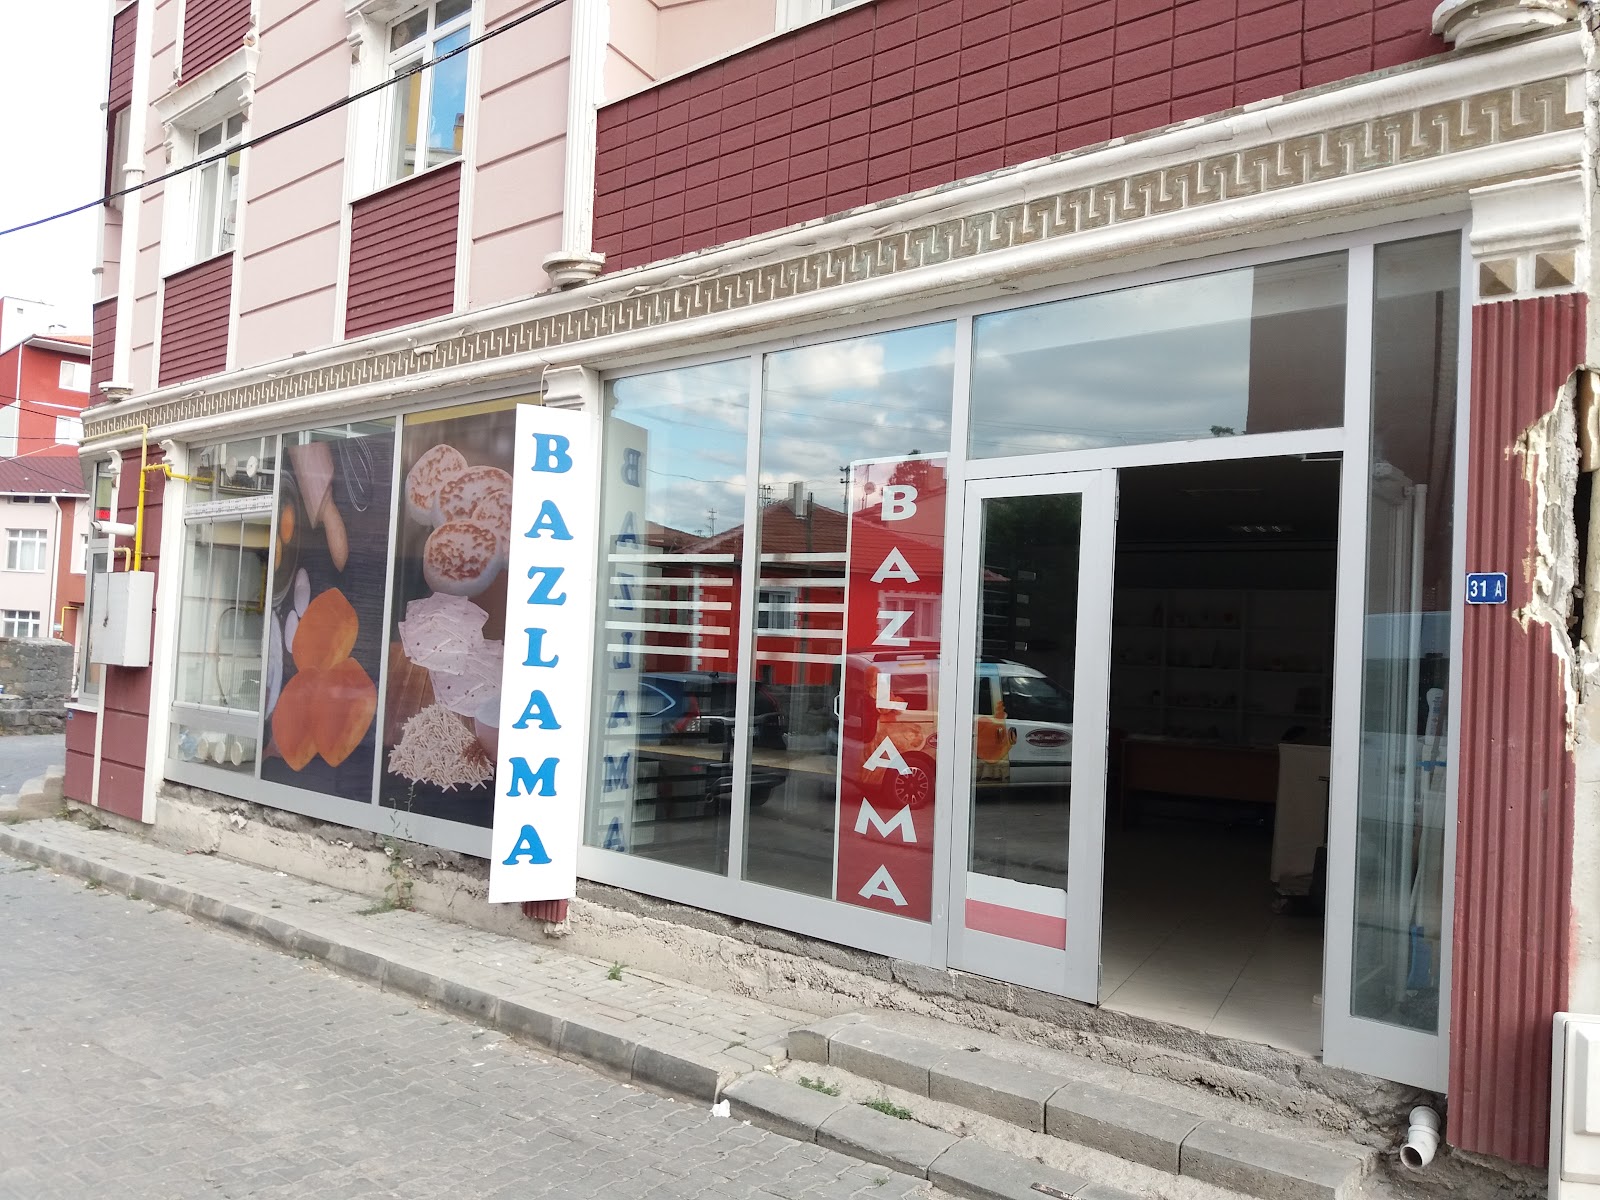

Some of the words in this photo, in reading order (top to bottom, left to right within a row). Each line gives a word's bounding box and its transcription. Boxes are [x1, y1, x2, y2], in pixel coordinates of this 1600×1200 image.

[502, 433, 574, 867] BAZLAMA
[853, 484, 921, 907] BAZLAMA
[1470, 580, 1487, 597] 31
[1495, 580, 1502, 597] A
